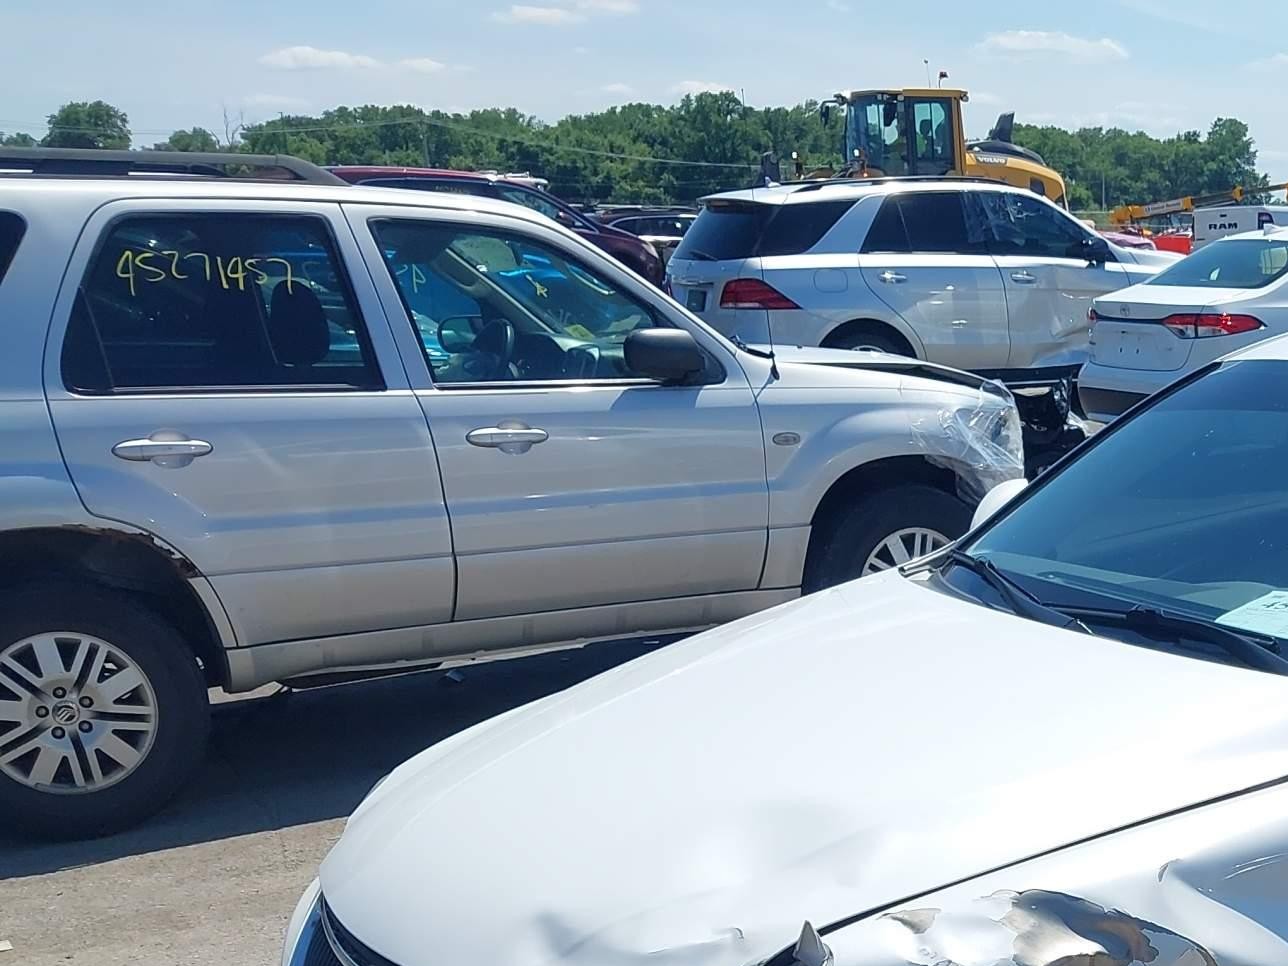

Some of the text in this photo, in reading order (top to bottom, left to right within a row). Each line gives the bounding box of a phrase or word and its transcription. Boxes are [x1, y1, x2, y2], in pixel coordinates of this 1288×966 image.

[977, 155, 1006, 164] VOLVO
[1208, 222, 1238, 230] RAM
[116, 250, 292, 296] 45271457
